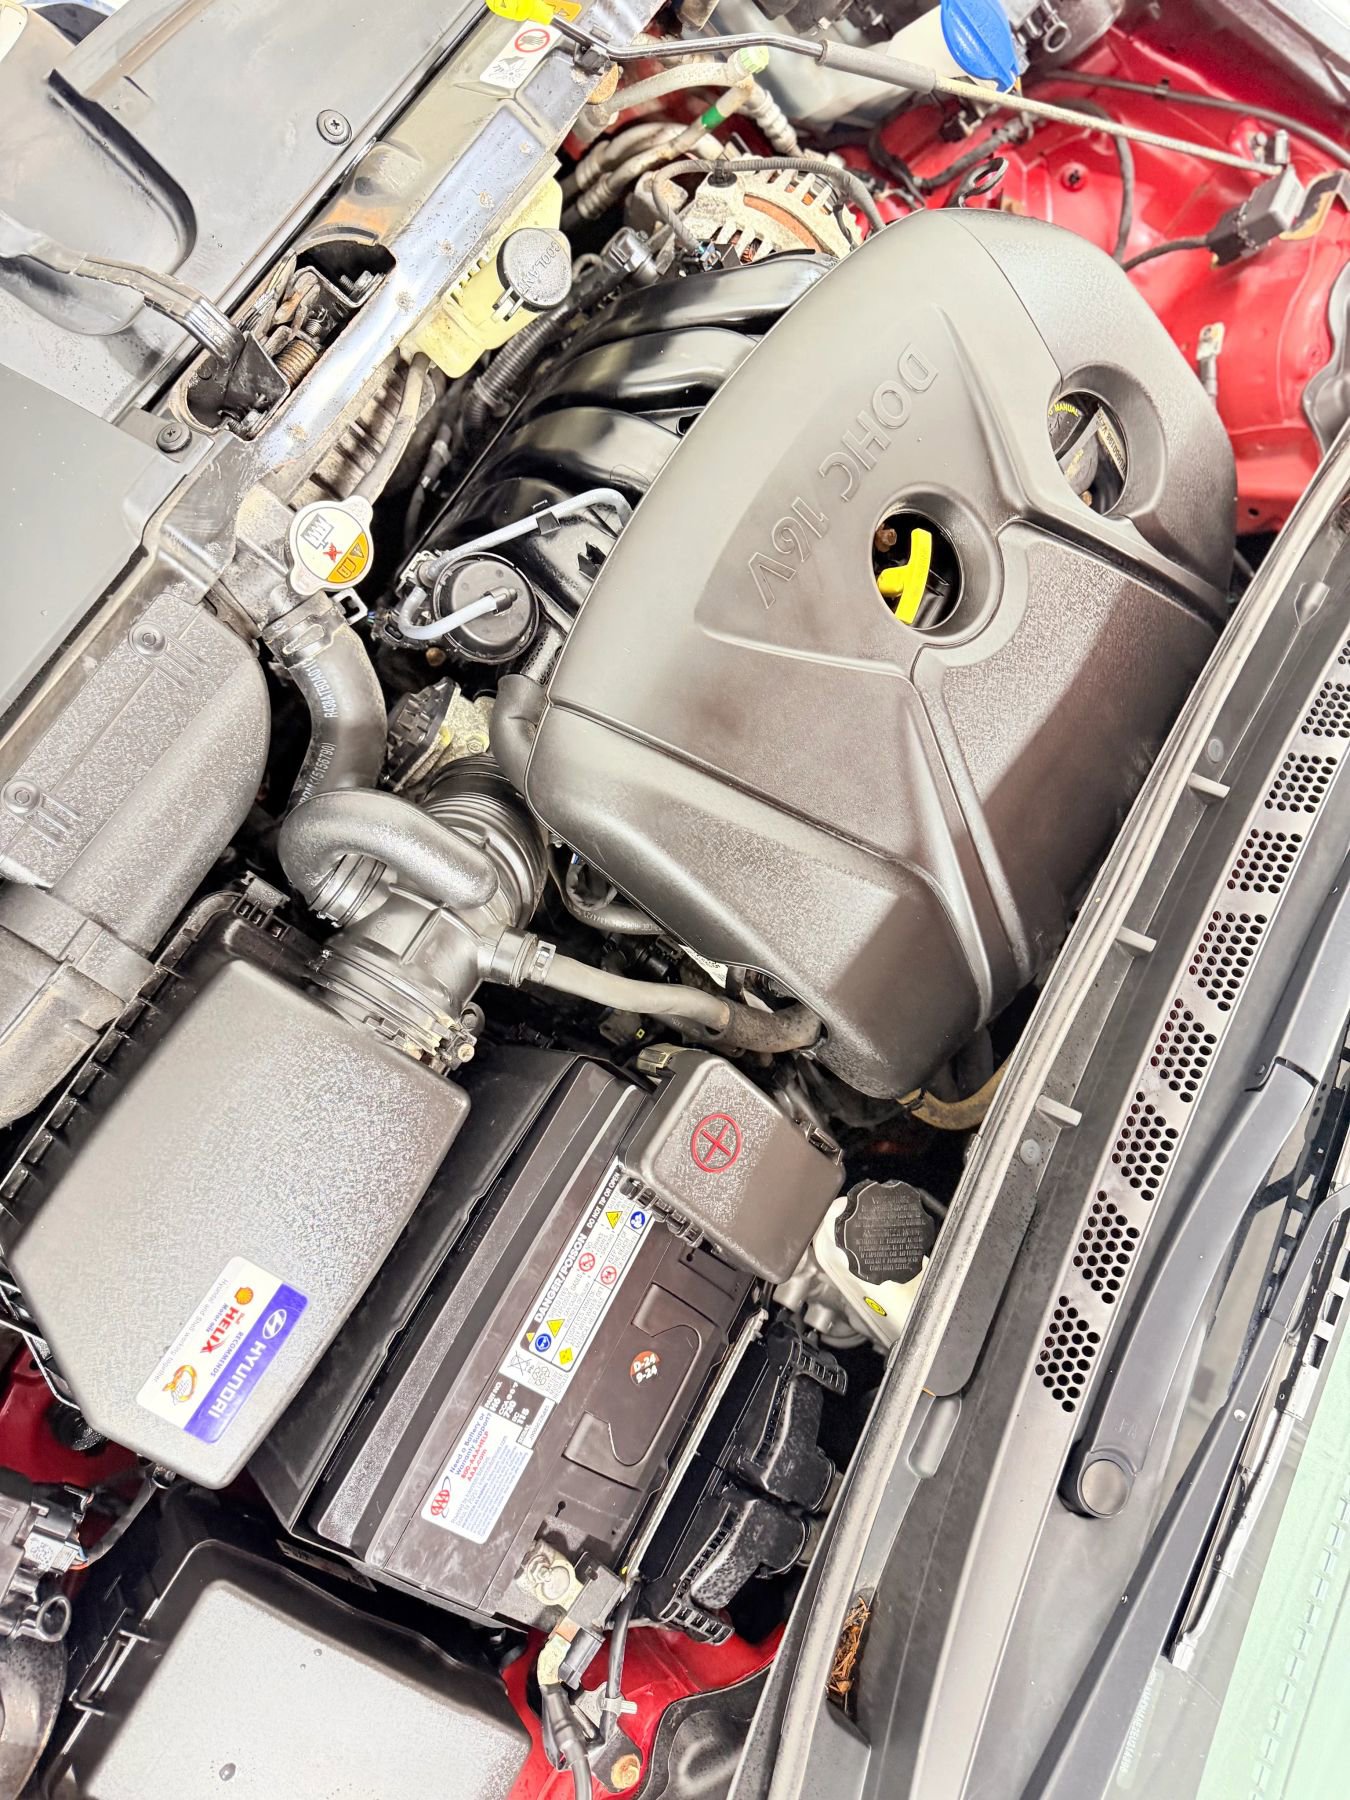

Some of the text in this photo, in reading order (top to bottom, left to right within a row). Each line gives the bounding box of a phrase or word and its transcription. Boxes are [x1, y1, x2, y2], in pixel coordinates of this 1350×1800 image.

[514, 240, 562, 293] COOLANT
[1054, 402, 1079, 418] MANUAL
[748, 343, 939, 609] DOHC 16V
[586, 1171, 621, 1228] DO NOT TIP OR OPEN
[533, 1233, 588, 1322] DANGER/POISON
[200, 1307, 239, 1353] HELIX
[212, 1302, 229, 1322] Motor
[210, 1332, 243, 1377] RECOMMENDS
[208, 1341, 266, 1418] HYUNDAI
[489, 1396, 501, 1411] H6
[502, 1399, 517, 1418] 730
[516, 1406, 530, 1425] 115
[449, 1453, 463, 1473] Need
[463, 1420, 481, 1446] Battery
[478, 1412, 485, 1420] or
[454, 1443, 476, 1476] Warranty
[471, 1412, 492, 1444] Support?
[460, 1430, 490, 1479] 800-AAA-HELP
[466, 1447, 488, 1481] AAA.com
[431, 1490, 451, 1515] AAA
